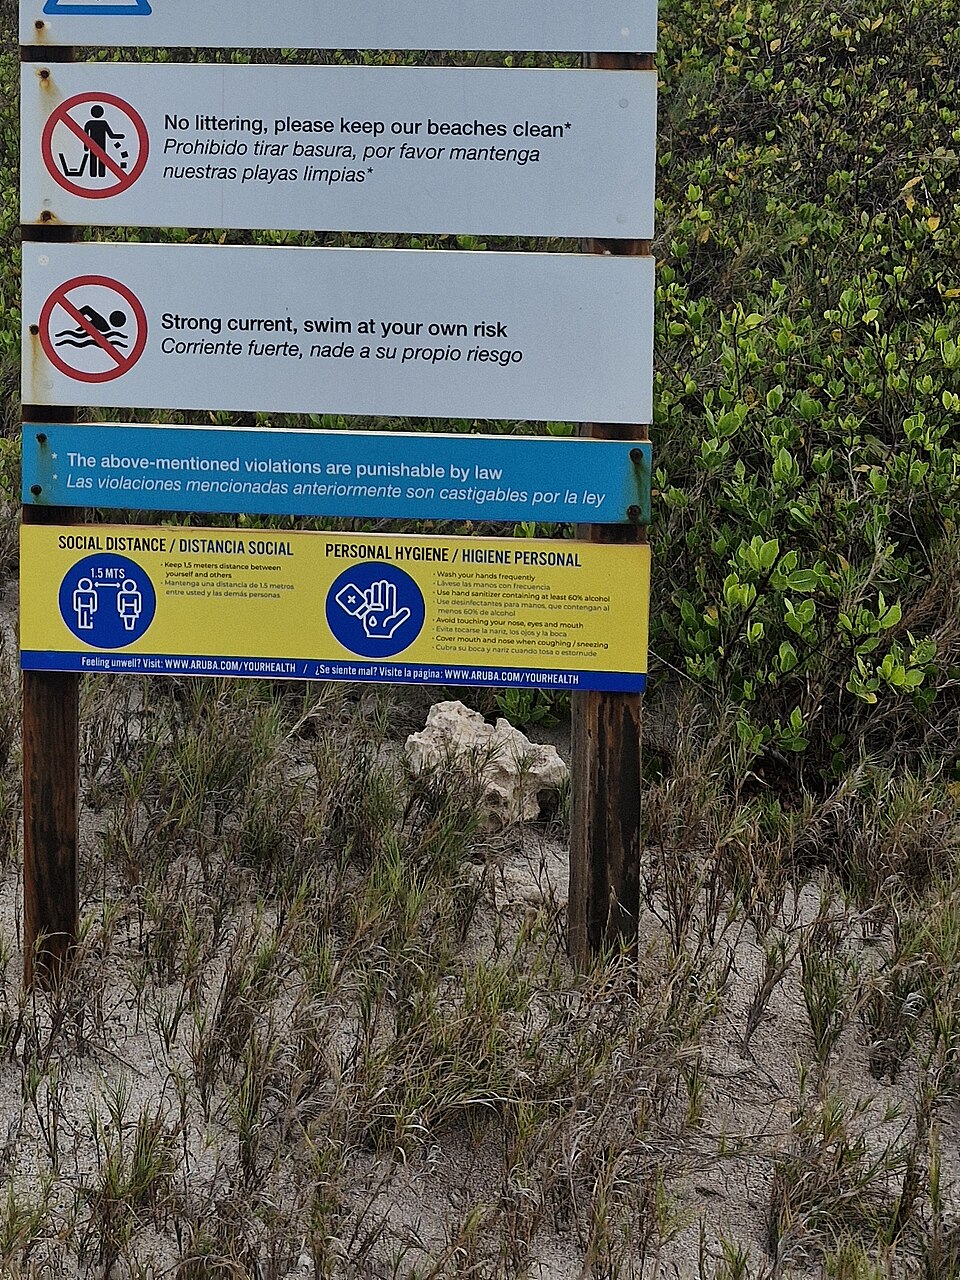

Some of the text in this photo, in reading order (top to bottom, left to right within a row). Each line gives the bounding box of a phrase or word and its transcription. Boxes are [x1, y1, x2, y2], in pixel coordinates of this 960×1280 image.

[164, 114, 190, 130] No
[195, 114, 268, 135] littering,
[274, 115, 335, 136] please
[340, 116, 385, 138] keep
[390, 121, 423, 135] our
[427, 118, 507, 136] beaches
[163, 138, 540, 166] Prohibido tirar basura, por favor mantenga
[162, 163, 237, 180] nuestras
[240, 163, 298, 185] playas
[161, 313, 508, 339] Strong current, swim at your own risk
[161, 337, 523, 367] Corriente fuerte, nade a su propio riesgo
[66, 452, 503, 483] The above-mentioned violations are punishable by law
[66, 473, 606, 508] Las violaciones mencionadas anteriormente son castigables por la ley
[58, 535, 294, 556] SOCIAL DISTANCE / DISTANCIA SOCIAL
[325, 542, 582, 567] PERSONAL HYGIENE / HIGIENE PERSONAL
[90, 567, 126, 579] 1.5 MTS
[164, 561, 183, 569] Keep
[250, 563, 282, 571] between
[165, 570, 194, 578] yourself
[209, 571, 232, 579] others
[436, 570, 536, 583] Wash your hands frequently
[436, 588, 450, 596] Use
[451, 589, 470, 597] hand
[470, 590, 501, 598] sanitizer
[501, 592, 540, 601] containing
[549, 592, 567, 601] least
[567, 593, 583, 601] 60%
[583, 594, 610, 603] alcohol
[435, 616, 456, 624] Avoid
[456, 617, 489, 627] touching
[489, 619, 506, 627] your
[559, 621, 584, 629] mouth
[435, 635, 456, 643] Cover
[482, 636, 497, 644] and
[536, 639, 572, 648] coughing
[571, 639, 576, 648] /
[576, 640, 609, 650] sneezing
[81, 656, 579, 684] Feeling unwell? Visit: WWW.ARUBA.COM/YOURHEALTH / ¿Se siente mal? Visite la página: WWW.ARUBA.COM/YOURHEALTH
